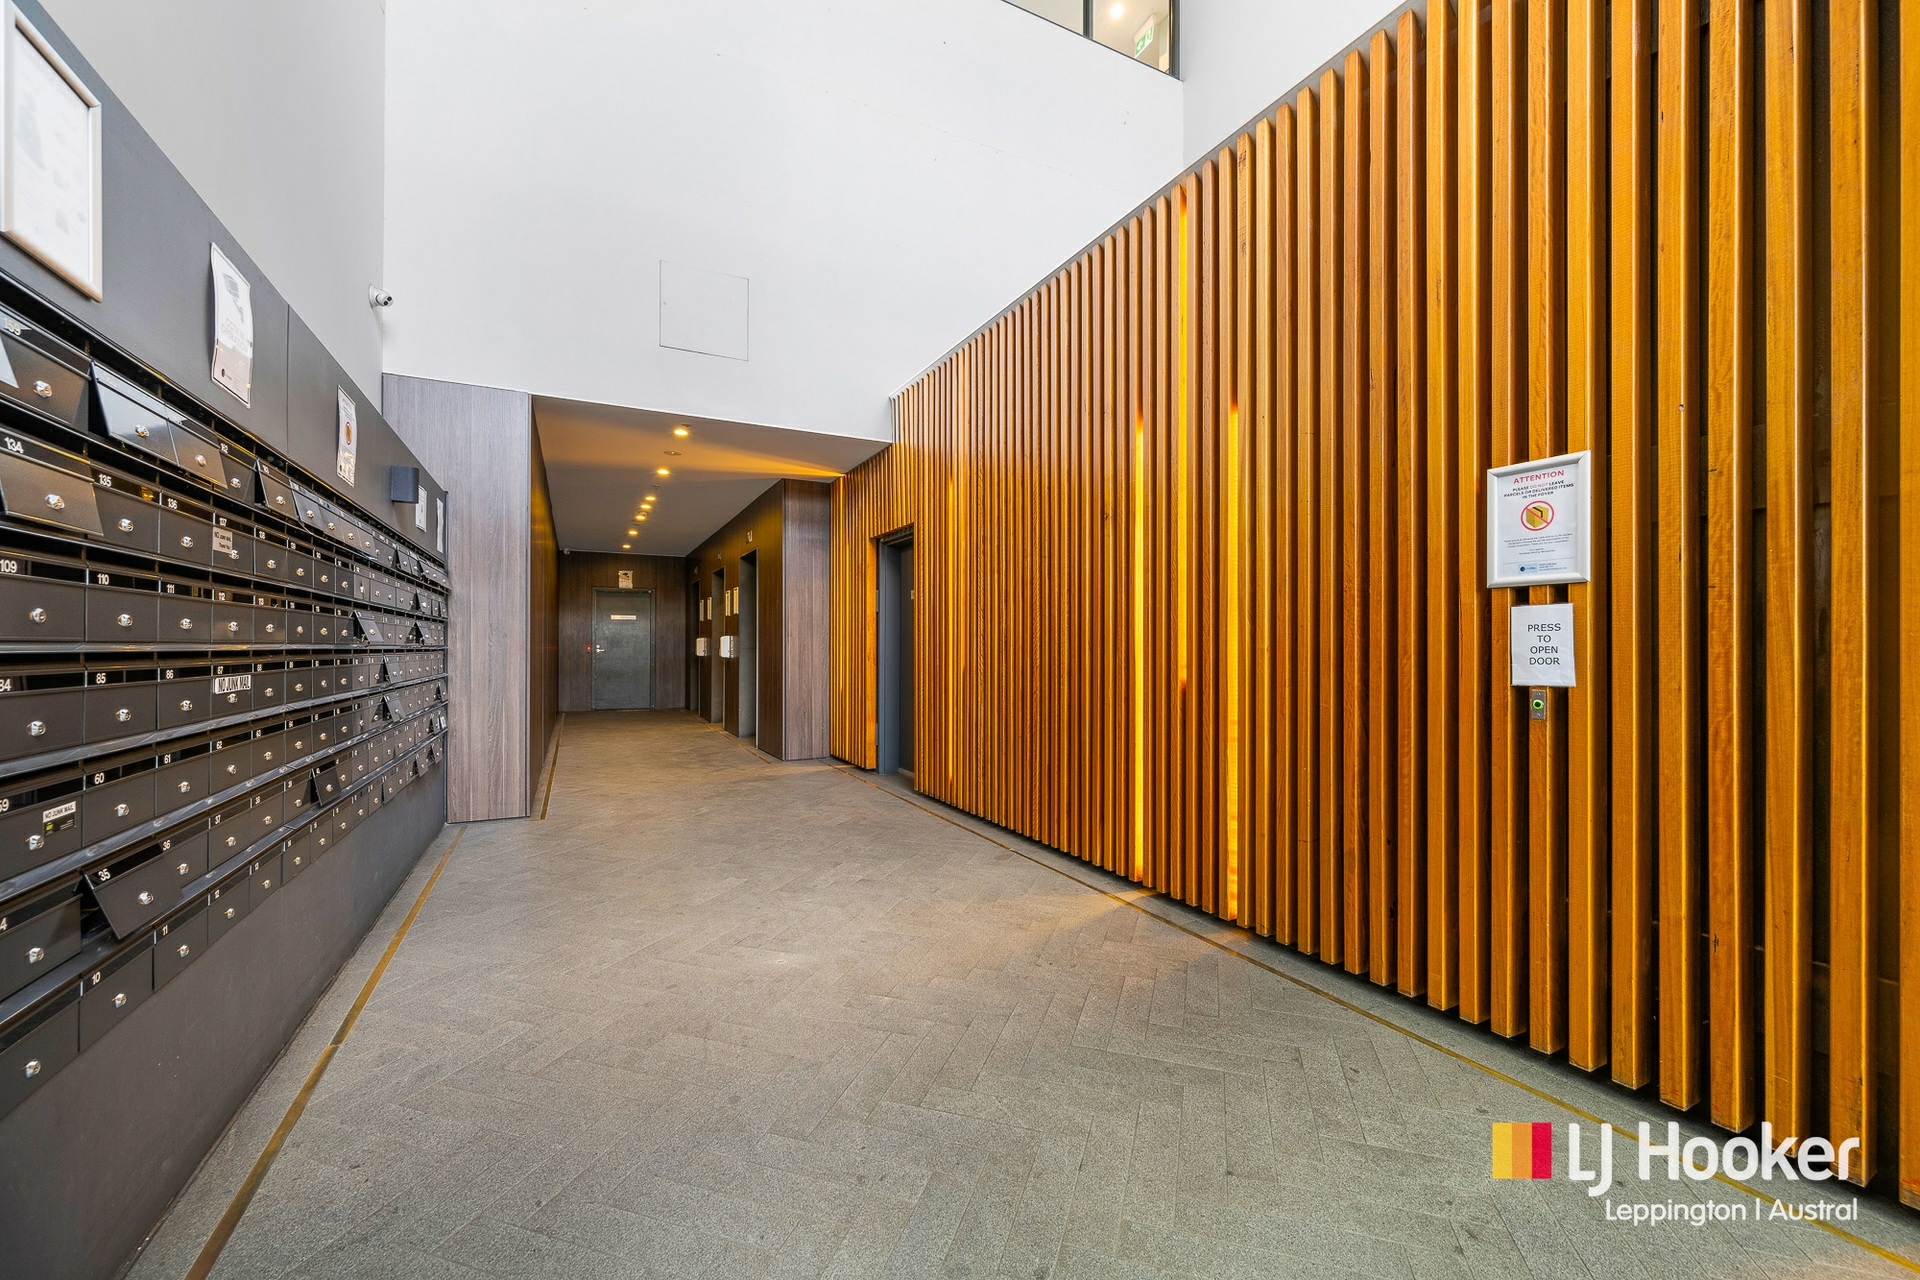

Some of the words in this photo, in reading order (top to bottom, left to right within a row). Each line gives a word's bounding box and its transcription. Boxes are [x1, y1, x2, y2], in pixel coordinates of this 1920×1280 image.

[4, 436, 24, 454] 134
[98, 473, 112, 487] 135
[1513, 469, 1565, 484] ATTENTION
[167, 498, 178, 510] 136
[0, 559, 17, 573] 109
[97, 573, 110, 585] 110
[166, 584, 175, 594] 111
[218, 592, 226, 601] 112
[1527, 622, 1562, 632] PRESS
[1536, 634, 1552, 643] TO
[1530, 645, 1559, 654] OPEN
[1529, 657, 1561, 666] DOOR
[165, 669, 174, 680] 86
[217, 665, 224, 675] 87
[95, 672, 107, 684] 85
[218, 678, 226, 693] NO
[226, 677, 239, 691] JUNK
[239, 675, 250, 689] MAIL
[216, 740, 223, 750] 62
[163, 753, 171, 764] 61
[94, 772, 105, 785] 60
[44, 810, 52, 819] NO
[52, 808, 64, 817] JUNK
[64, 804, 74, 814] MAIL
[214, 814, 221, 824] 37
[162, 840, 171, 851] 36
[98, 868, 111, 881] 35
[162, 924, 168, 936] 11
[91, 971, 101, 985] 10
